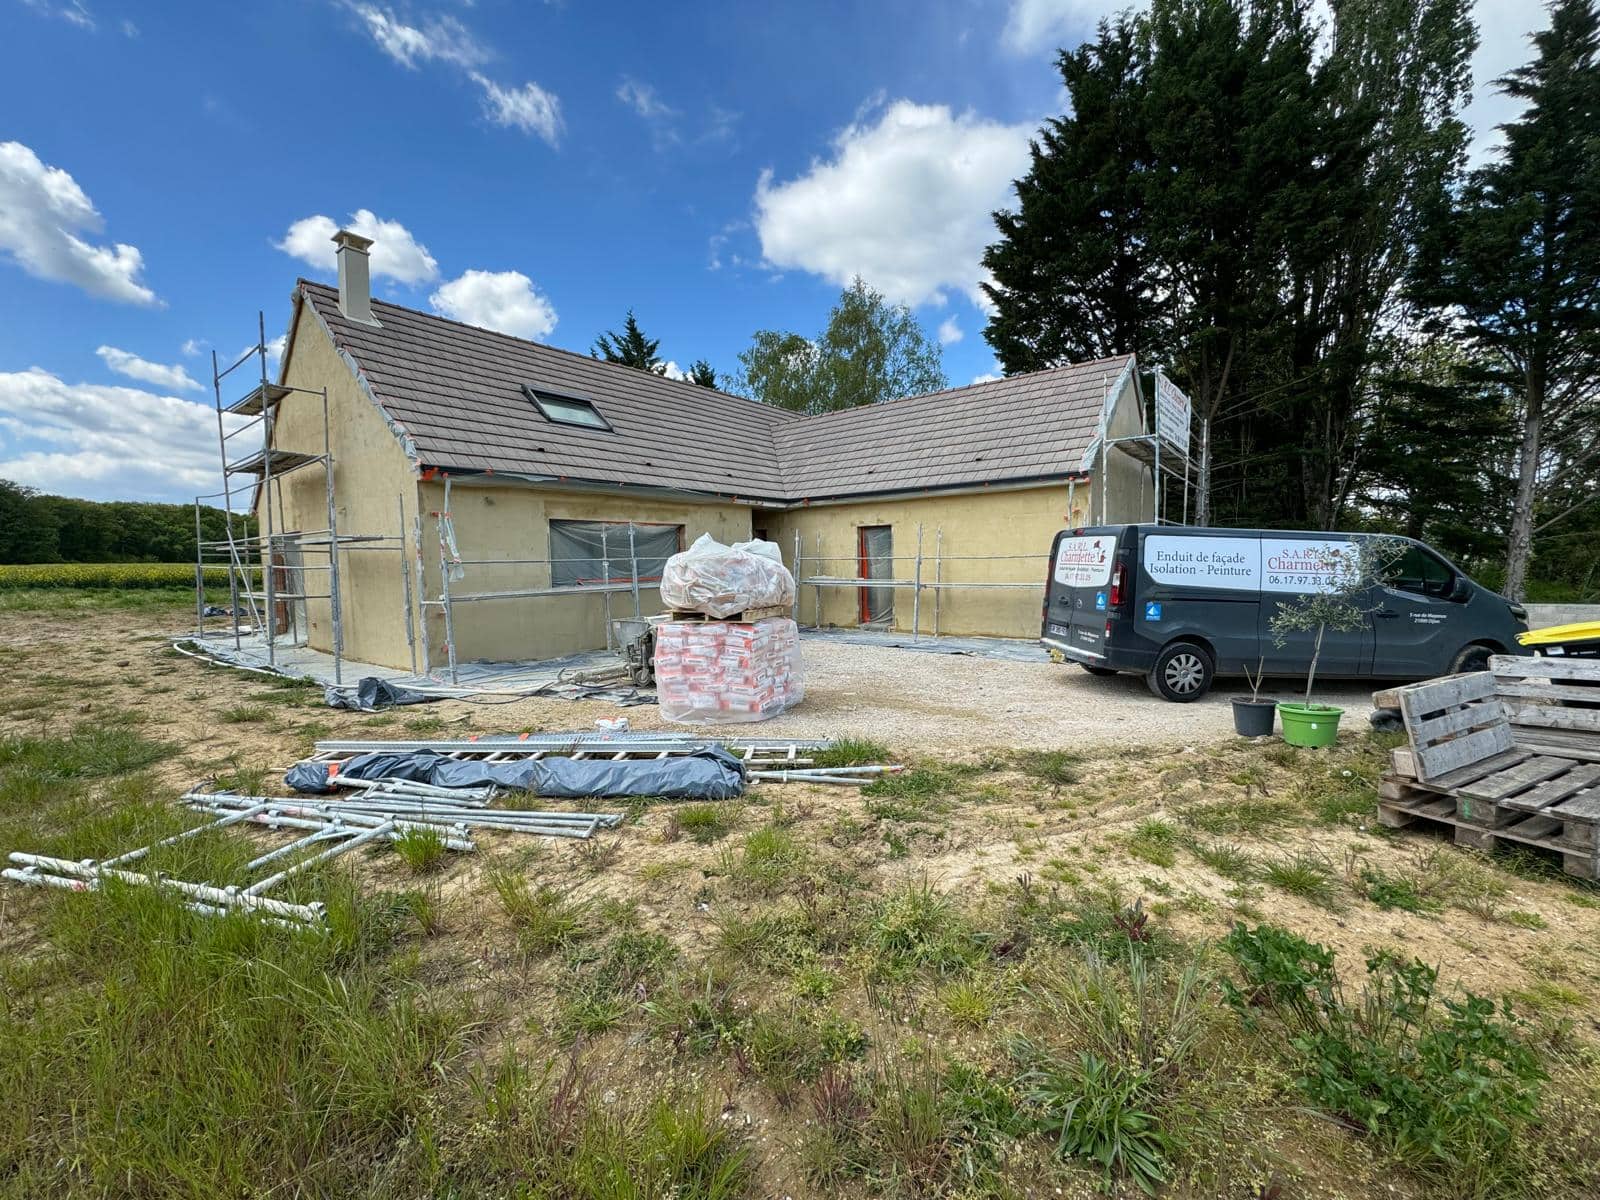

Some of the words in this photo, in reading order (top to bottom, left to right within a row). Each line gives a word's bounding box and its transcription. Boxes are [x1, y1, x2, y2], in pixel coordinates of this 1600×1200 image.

[1157, 551, 1193, 562] Enduit
[1196, 552, 1209, 562] de
[1212, 552, 1245, 565] façade
[1150, 563, 1196, 574] Isolation
[1207, 565, 1252, 576] Peinture
